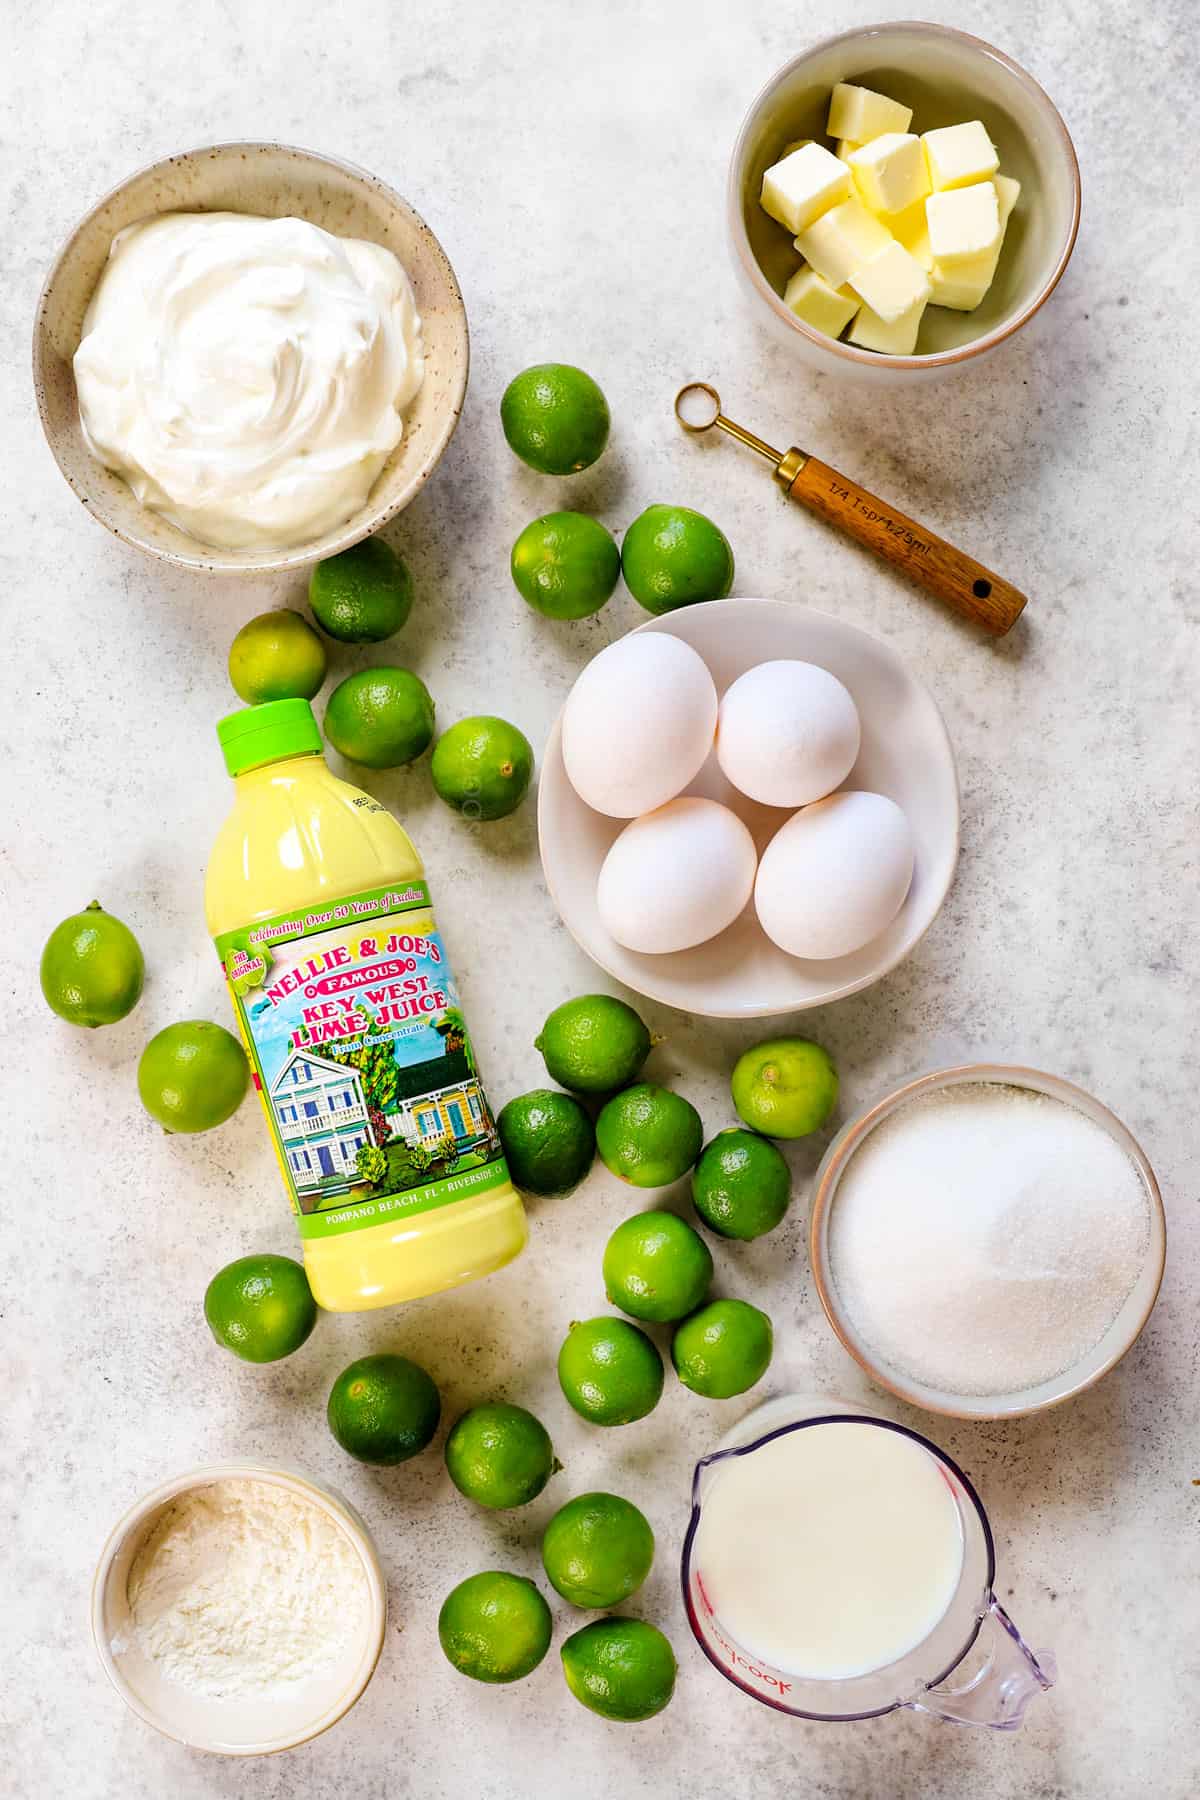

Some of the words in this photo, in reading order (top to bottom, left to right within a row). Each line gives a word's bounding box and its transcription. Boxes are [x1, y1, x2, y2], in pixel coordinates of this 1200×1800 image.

[250, 919, 303, 943] Celebrating
[306, 910, 331, 927] Over
[335, 904, 349, 919] 50
[351, 900, 378, 915] Years
[381, 892, 391, 912] of
[231, 957, 263, 979] ORIGINAL
[233, 951, 248, 964] THE
[267, 946, 351, 1006] NELLIE
[360, 938, 378, 958] &
[386, 935, 441, 962] JOE'S
[327, 964, 399, 989] FAMOUS
[303, 995, 355, 1022] KEY
[364, 976, 428, 1004] WEST
[291, 1013, 368, 1048] LIME
[375, 990, 448, 1025] JUICE
[331, 1041, 363, 1056] From
[364, 1022, 426, 1045] Concentrate
[326, 1206, 375, 1224] POMPANO
[425, 1187, 438, 1200] FL
